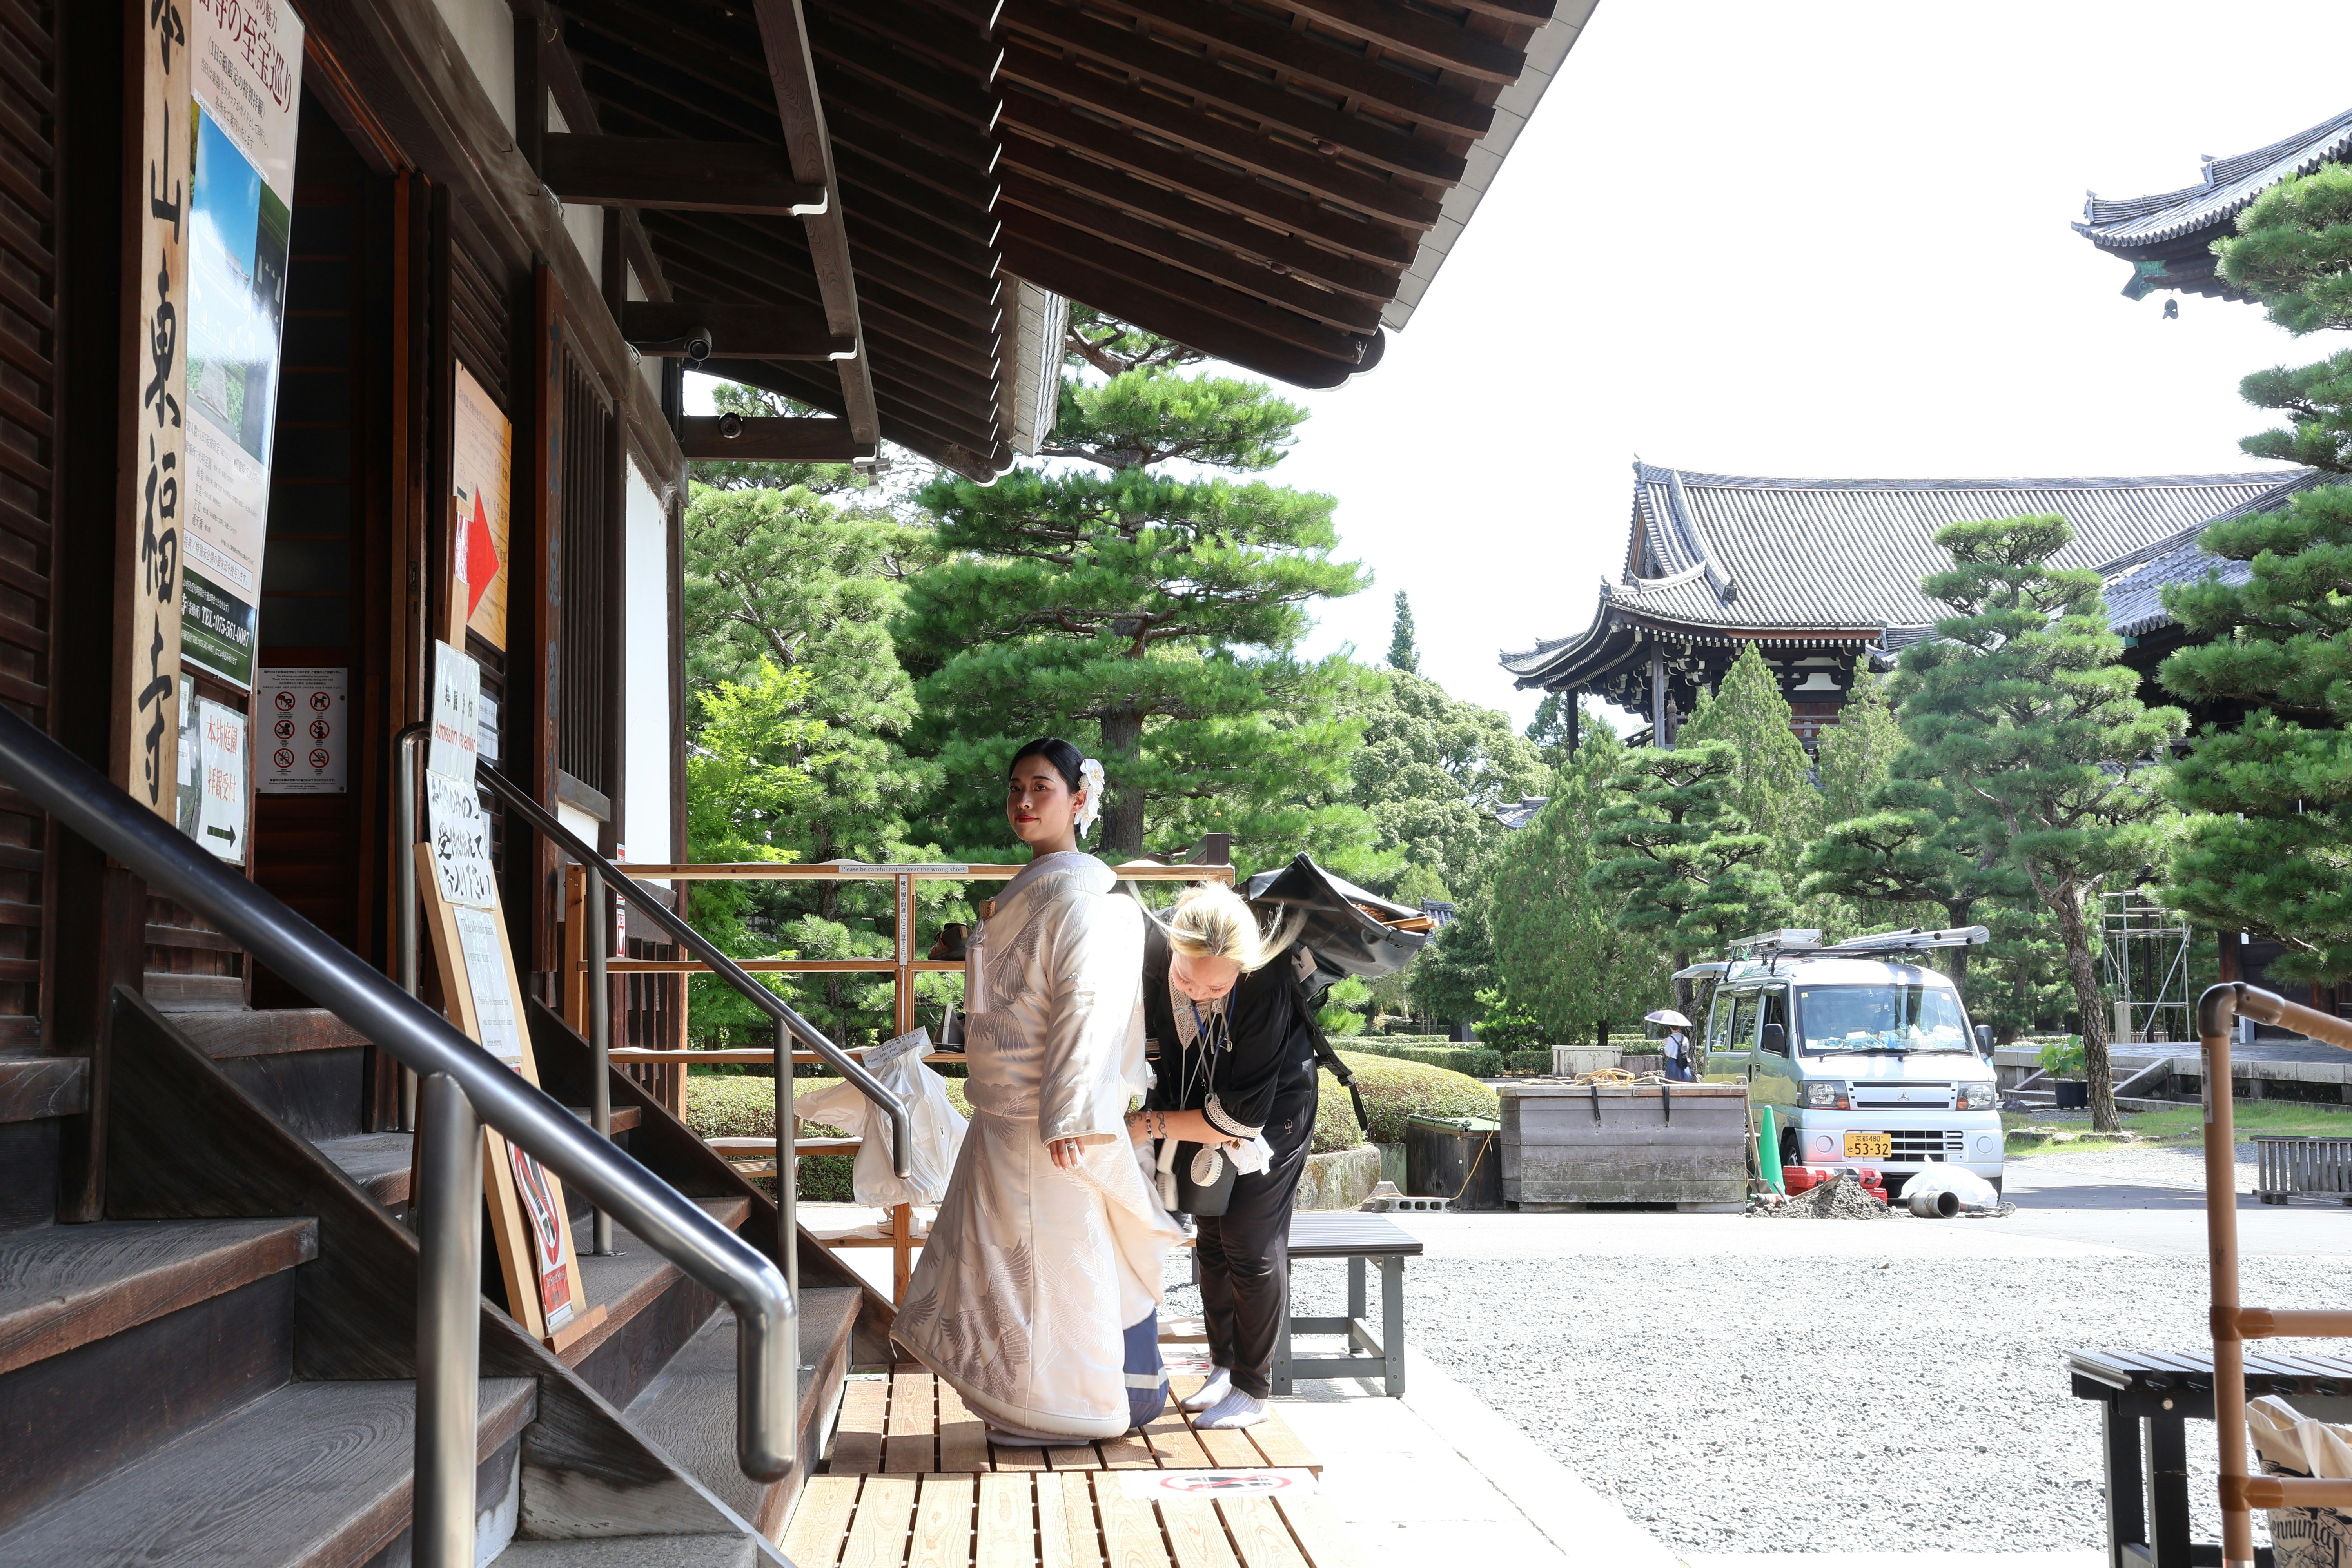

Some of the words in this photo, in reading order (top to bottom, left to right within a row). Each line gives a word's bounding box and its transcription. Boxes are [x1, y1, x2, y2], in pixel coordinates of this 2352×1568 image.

[206, 715, 238, 754] 本坊庭園
[435, 718, 457, 746] Admission
[208, 764, 236, 804] 拝観受付
[1855, 1143, 1889, 1156] 53-32
